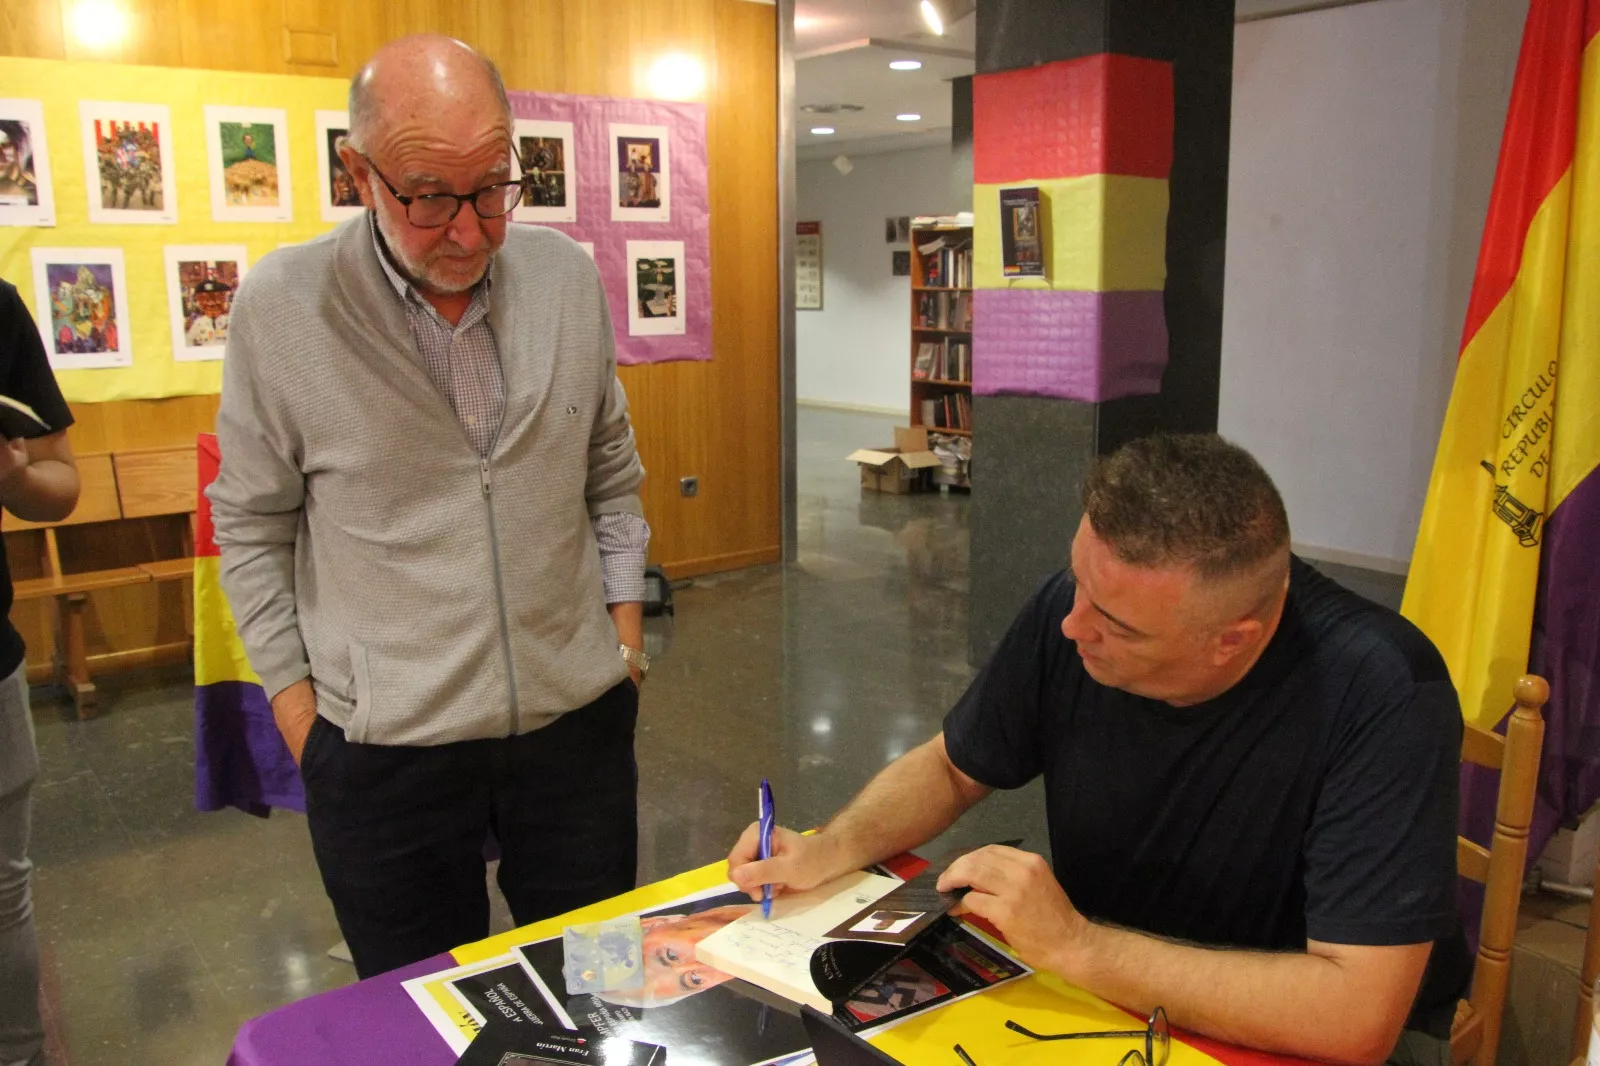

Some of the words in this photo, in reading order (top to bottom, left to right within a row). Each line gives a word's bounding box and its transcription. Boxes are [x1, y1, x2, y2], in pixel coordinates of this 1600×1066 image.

[1502, 360, 1557, 440] CIRCULO
[497, 982, 518, 1001] ESPAÑA
[484, 988, 517, 1019] ESPAÑOL
[513, 999, 525, 1008] DE
[536, 1042, 567, 1053] Martín
[568, 1047, 589, 1057] Fran
